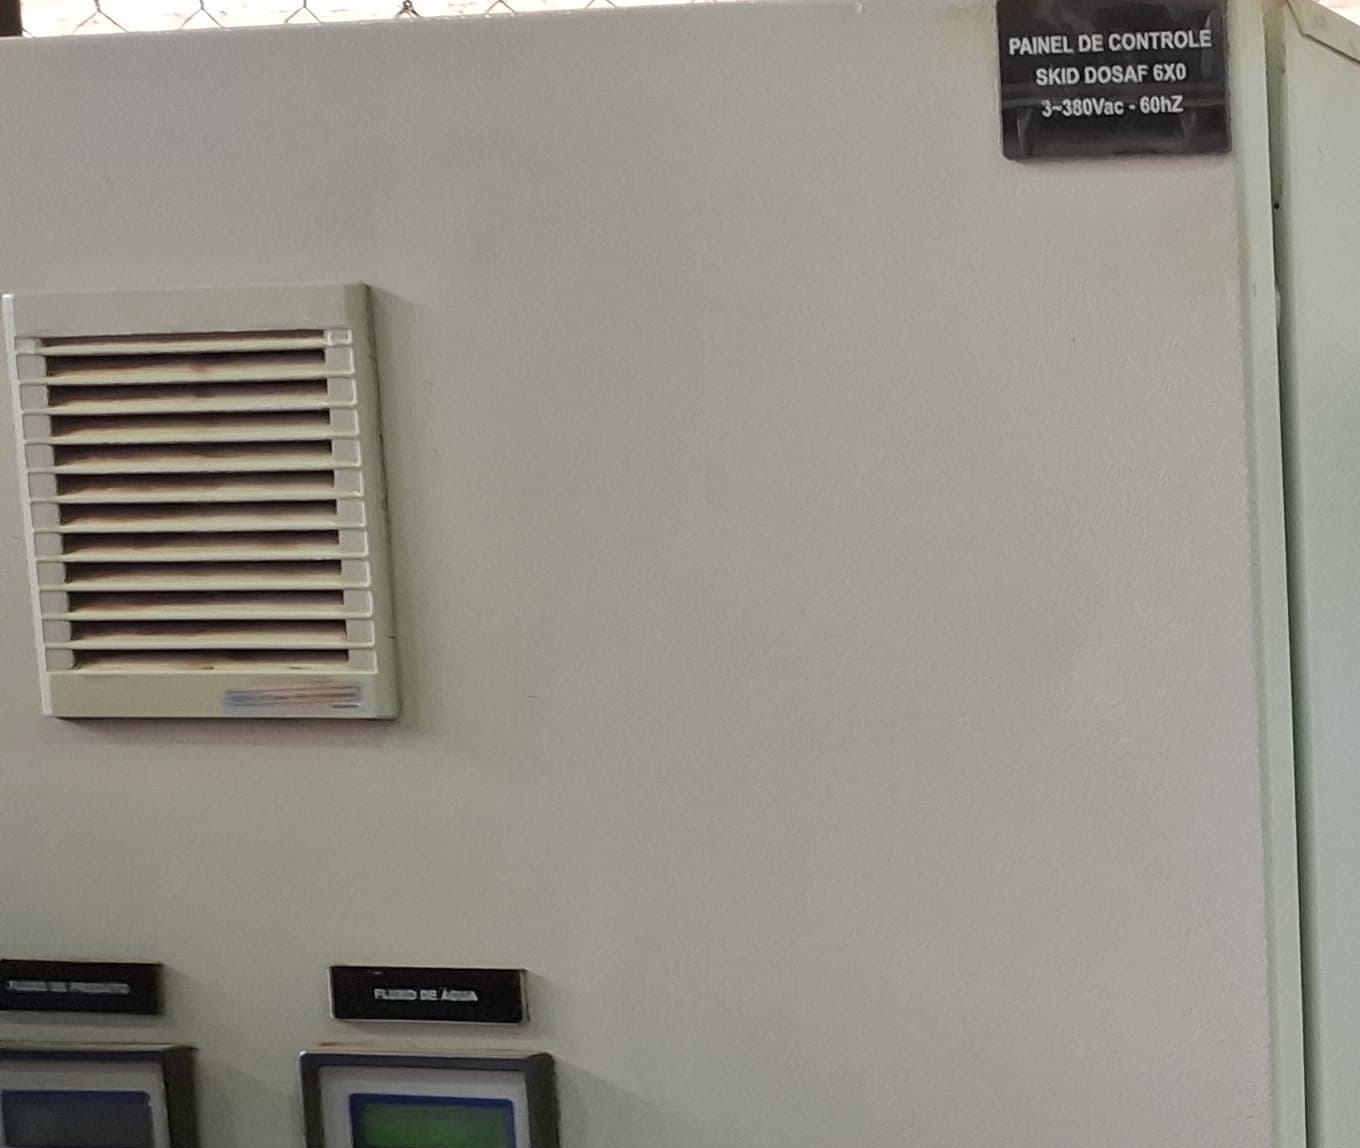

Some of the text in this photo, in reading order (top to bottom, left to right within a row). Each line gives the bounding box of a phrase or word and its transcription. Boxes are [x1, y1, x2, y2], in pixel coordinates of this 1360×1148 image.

[1008, 29, 1213, 55] PAINEL DE CONTROLE
[1035, 62, 1187, 86] SKID DOSAF 6X0
[1041, 97, 1125, 118] 3~380Vac
[1139, 95, 1184, 114] 60hZ
